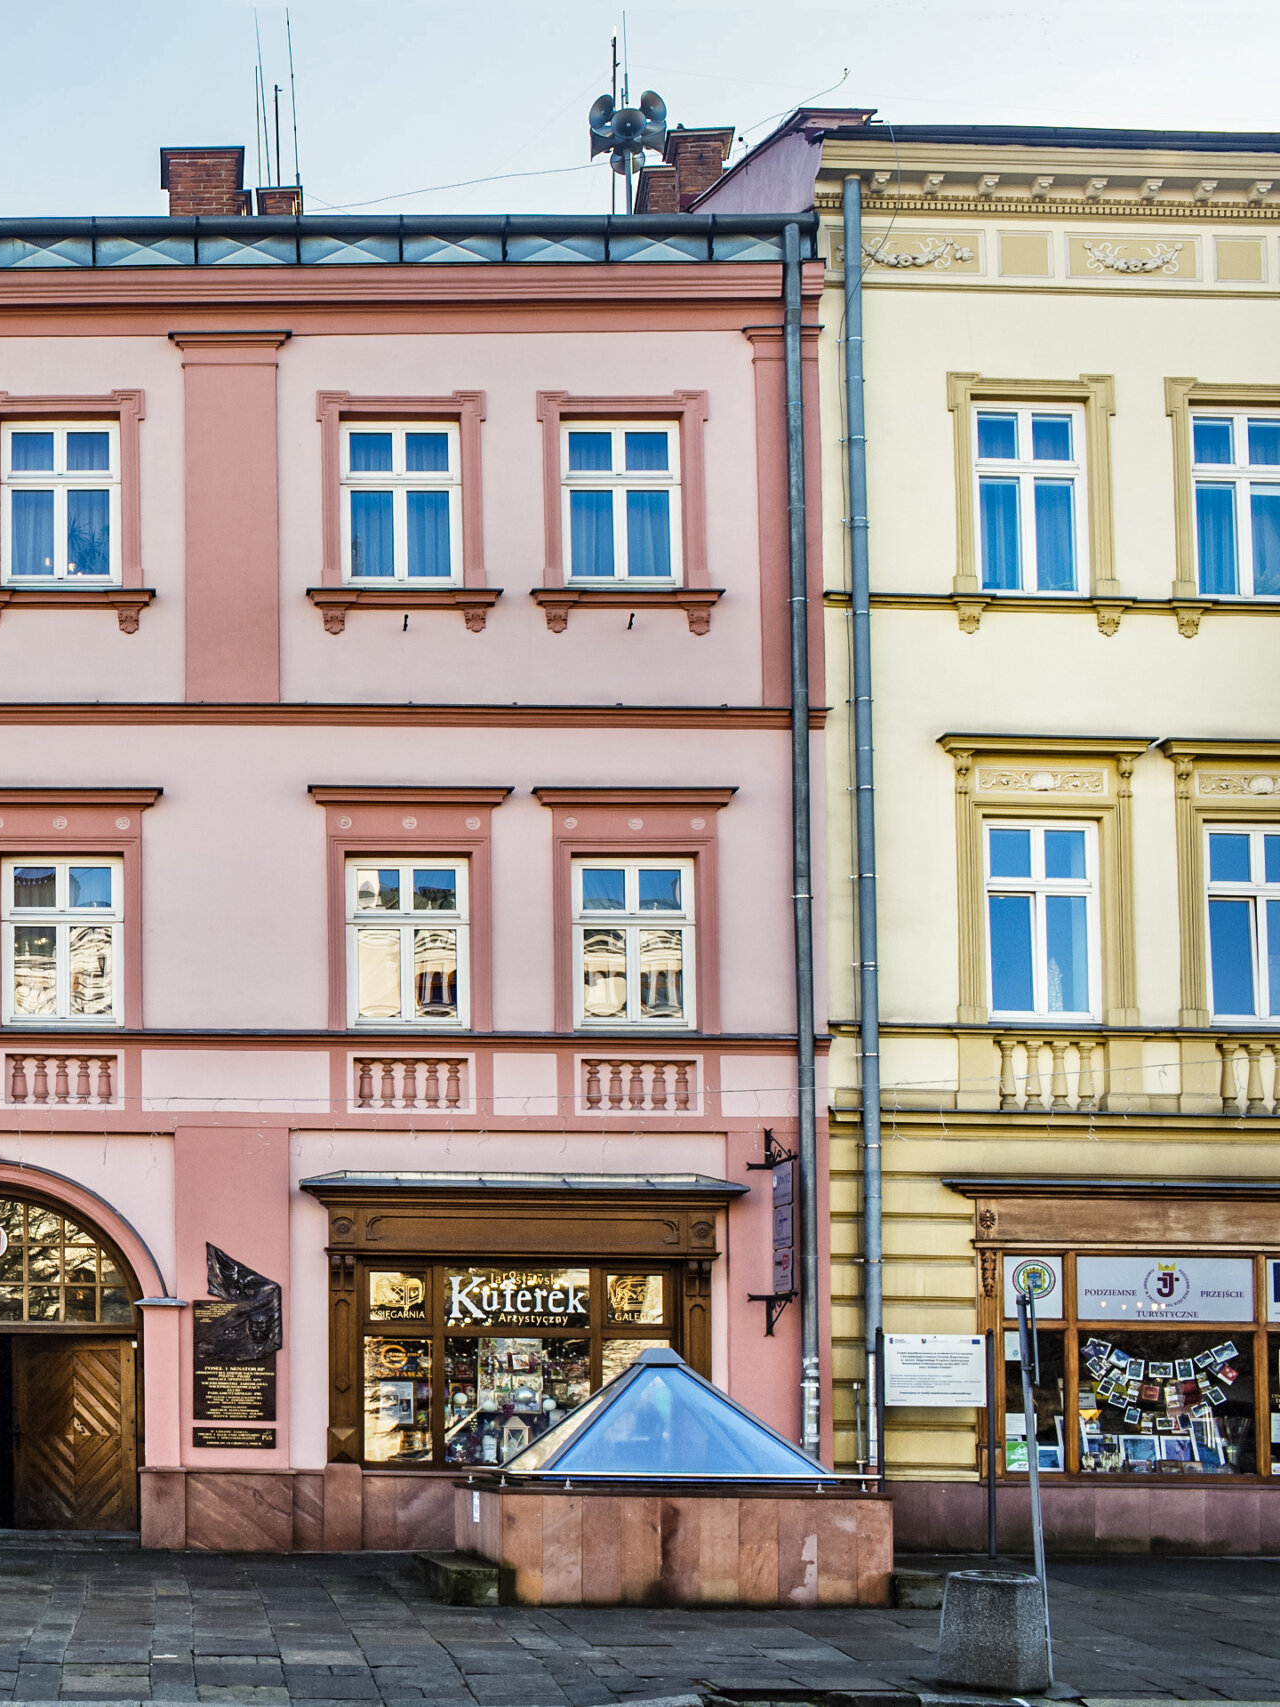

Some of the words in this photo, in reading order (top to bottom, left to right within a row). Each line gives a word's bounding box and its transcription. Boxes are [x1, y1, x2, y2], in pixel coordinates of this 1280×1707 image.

[448, 1276, 587, 1318] Kuferek
[1084, 1288, 1137, 1297] PODZIEMNE
[1200, 1289, 1245, 1298] PRZEJŚCIE
[371, 1310, 425, 1320] KSIĘGARNIA
[498, 1312, 569, 1326] Artystyczny
[1136, 1310, 1200, 1319] TURYSTYCZNE
